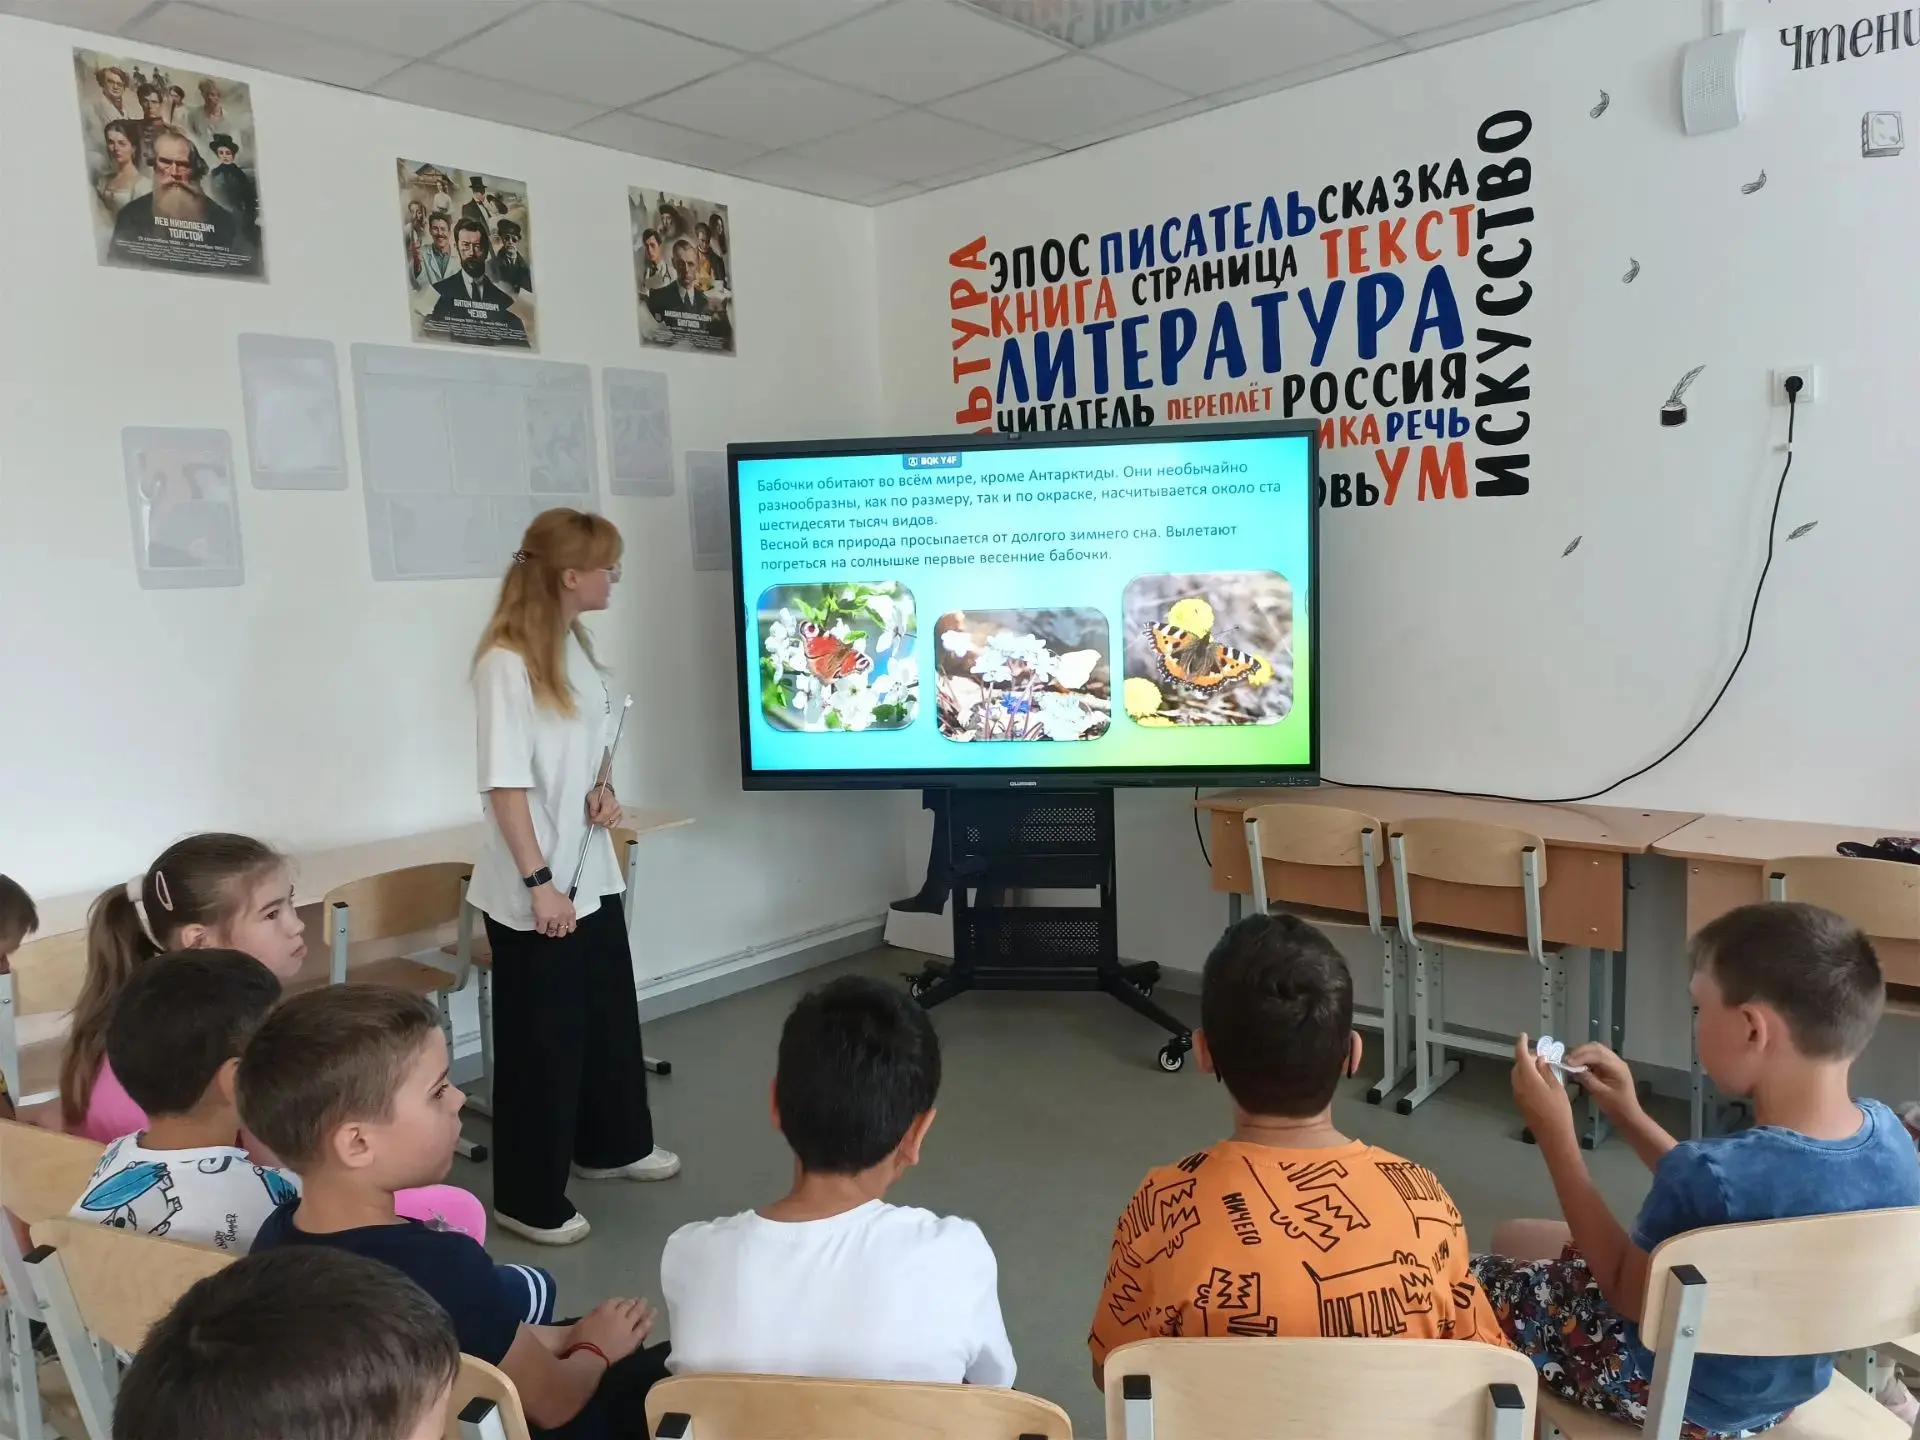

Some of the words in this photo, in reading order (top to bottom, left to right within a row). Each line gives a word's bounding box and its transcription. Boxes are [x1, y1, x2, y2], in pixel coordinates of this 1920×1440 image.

[1317, 157, 1470, 224] СКАЗКА
[154, 216, 169, 227] ЛЕВ
[168, 228, 204, 242] ТОЛСТОЙ
[1099, 190, 1317, 275] ПИСАТЕЛЬ
[1319, 203, 1475, 280] ТЕКСТ
[989, 233, 1090, 294] ЭПОС
[1131, 243, 1298, 306] СТРАНИЦА
[990, 277, 1118, 338] КНИГА
[1474, 108, 1534, 498] ИСКУССТВО
[948, 235, 994, 435] ЬТУРА
[996, 264, 1465, 404] ЛИТЕРАТУРА
[1167, 382, 1273, 421] ПЕРЕПЛЁТ
[1282, 351, 1468, 418] РОССИЯ
[996, 393, 1155, 433] ЧИТАТЕЛЬ
[1386, 406, 1471, 442] РЕЧЬ
[758, 478, 814, 492] Бабочки
[817, 476, 875, 489] обитают
[879, 477, 895, 488] во
[899, 474, 932, 486] всём
[936, 475, 977, 487] мире,
[981, 472, 1025, 485] кроме
[1029, 469, 1119, 482] Антарктиды.
[1123, 465, 1152, 478] Они
[1157, 460, 1248, 476] необычайно
[921, 456, 939, 465] BQK
[941, 455, 957, 464] Y4F
[1374, 441, 1469, 506] УМ
[758, 498, 861, 514] разнообразны,
[865, 497, 887, 508] как
[891, 496, 908, 507] по
[912, 494, 973, 507] размеру,
[977, 493, 999, 504] так
[1003, 493, 1012, 503] и
[1016, 492, 1033, 502] по
[1037, 489, 1097, 503] окраске,
[1101, 484, 1207, 499] насчитывается
[1211, 482, 1255, 495] около
[1259, 481, 1281, 493] ста
[759, 518, 845, 531] шестидесяти
[848, 517, 888, 529] тысяч
[892, 515, 938, 528] видов.
[760, 537, 809, 551] Весной
[812, 538, 834, 549] вся
[838, 535, 896, 550] природа
[900, 532, 989, 547] просыпается
[992, 533, 1008, 543] от
[1011, 530, 1066, 545] долгого
[1070, 528, 1129, 542] зимнего
[1133, 527, 1161, 540] сна.
[1166, 524, 1237, 538] Вылетают
[760, 557, 827, 573] погреться
[831, 557, 847, 568] на
[850, 554, 919, 568] солнышке
[924, 552, 975, 567] первые
[980, 551, 1045, 564] весенние
[1049, 548, 1112, 562] бабочки.
[224, 1212, 239, 1242] SUMMER
[1222, 1192, 1262, 1246] НИЧЕГО
